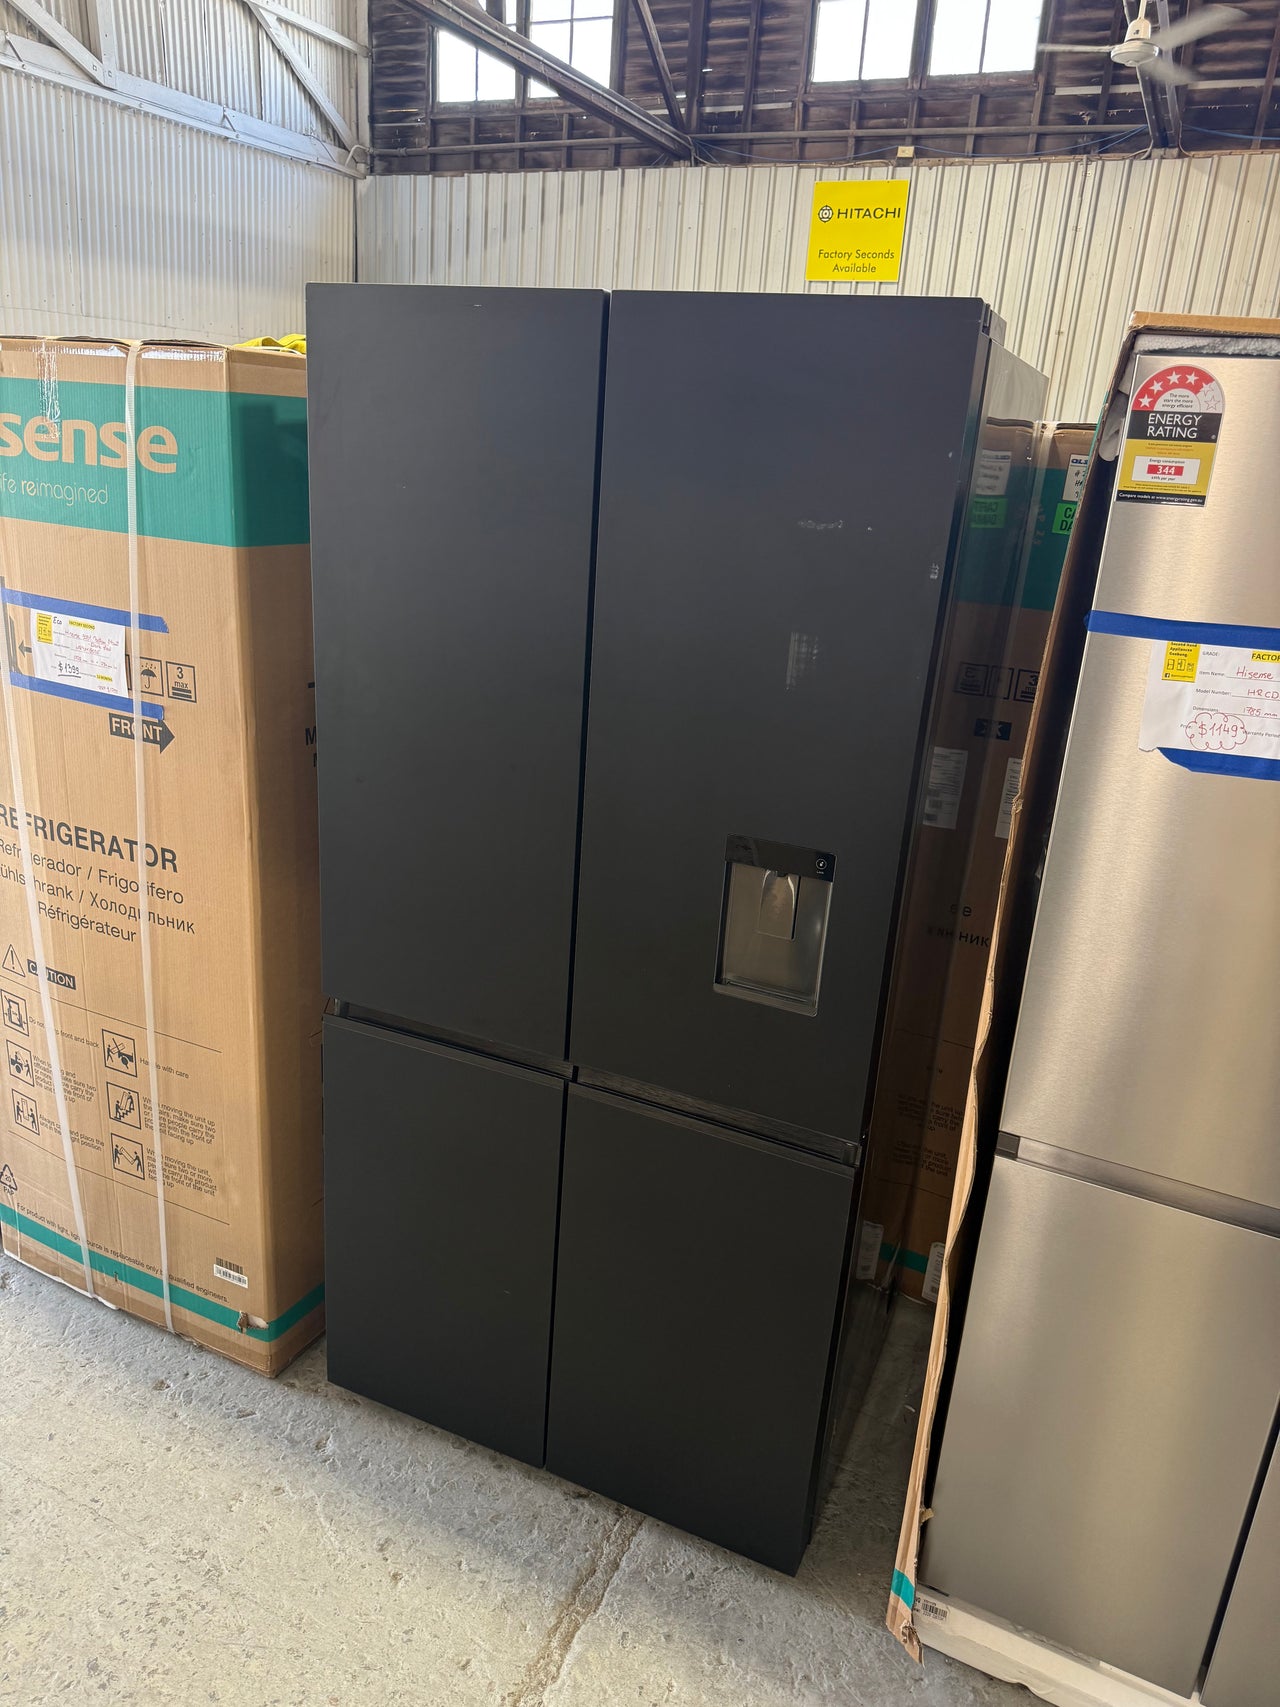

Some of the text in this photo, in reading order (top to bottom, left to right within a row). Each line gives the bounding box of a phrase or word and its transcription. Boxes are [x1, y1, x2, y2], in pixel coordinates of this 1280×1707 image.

[836, 207, 901, 220] HITACHI
[818, 248, 895, 261] Factory Seconds
[832, 263, 877, 273] Available
[1148, 413, 1202, 426] ENERGY
[1147, 426, 1198, 438] RATING
[1157, 466, 1175, 475] 344
[21, 478, 108, 506] reimagined
[176, 666, 184, 679] 3
[1236, 665, 1274, 680] Hisense
[174, 680, 188, 689] max
[1198, 721, 1238, 738] $1149
[38, 901, 137, 942] Réfrigérateur
